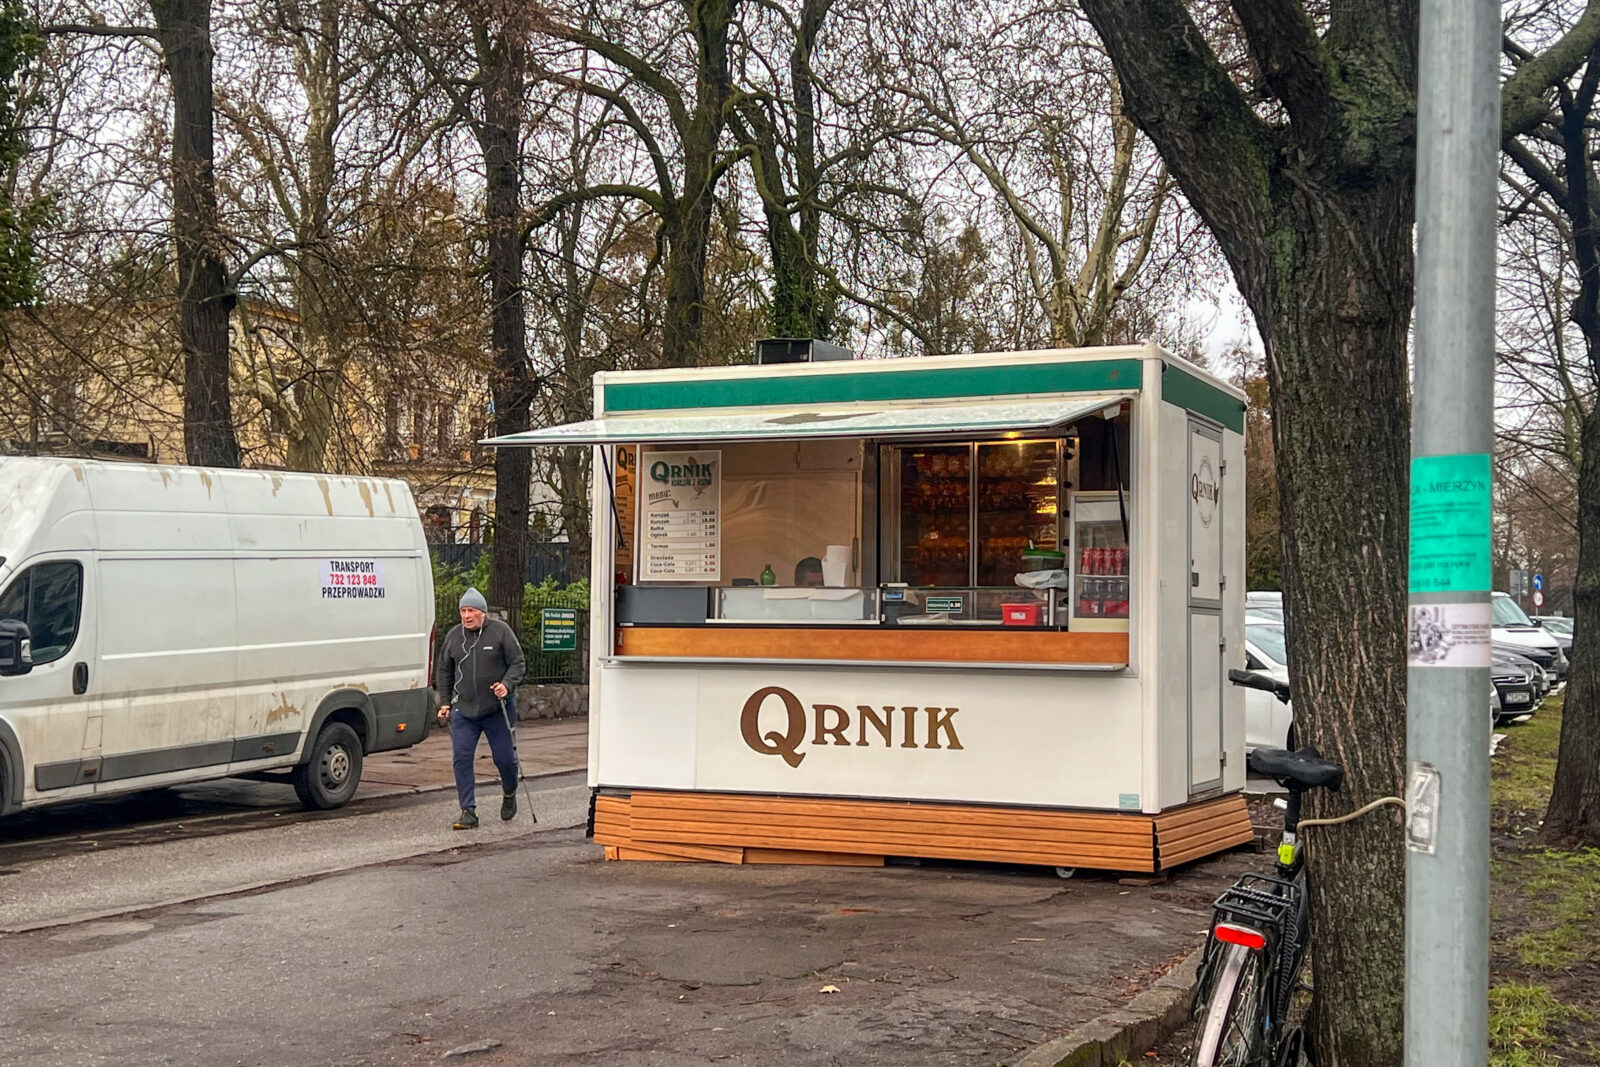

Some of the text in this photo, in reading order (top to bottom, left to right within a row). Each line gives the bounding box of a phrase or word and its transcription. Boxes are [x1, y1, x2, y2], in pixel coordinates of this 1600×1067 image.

[650, 461, 712, 485] QRNIK
[1429, 480, 1486, 494] MIERZYN
[330, 561, 375, 573] TRANSPORT
[330, 574, 377, 586] 732 123 848
[321, 586, 385, 599] PRZEPROWADZKI
[740, 686, 964, 768] QRNIK
